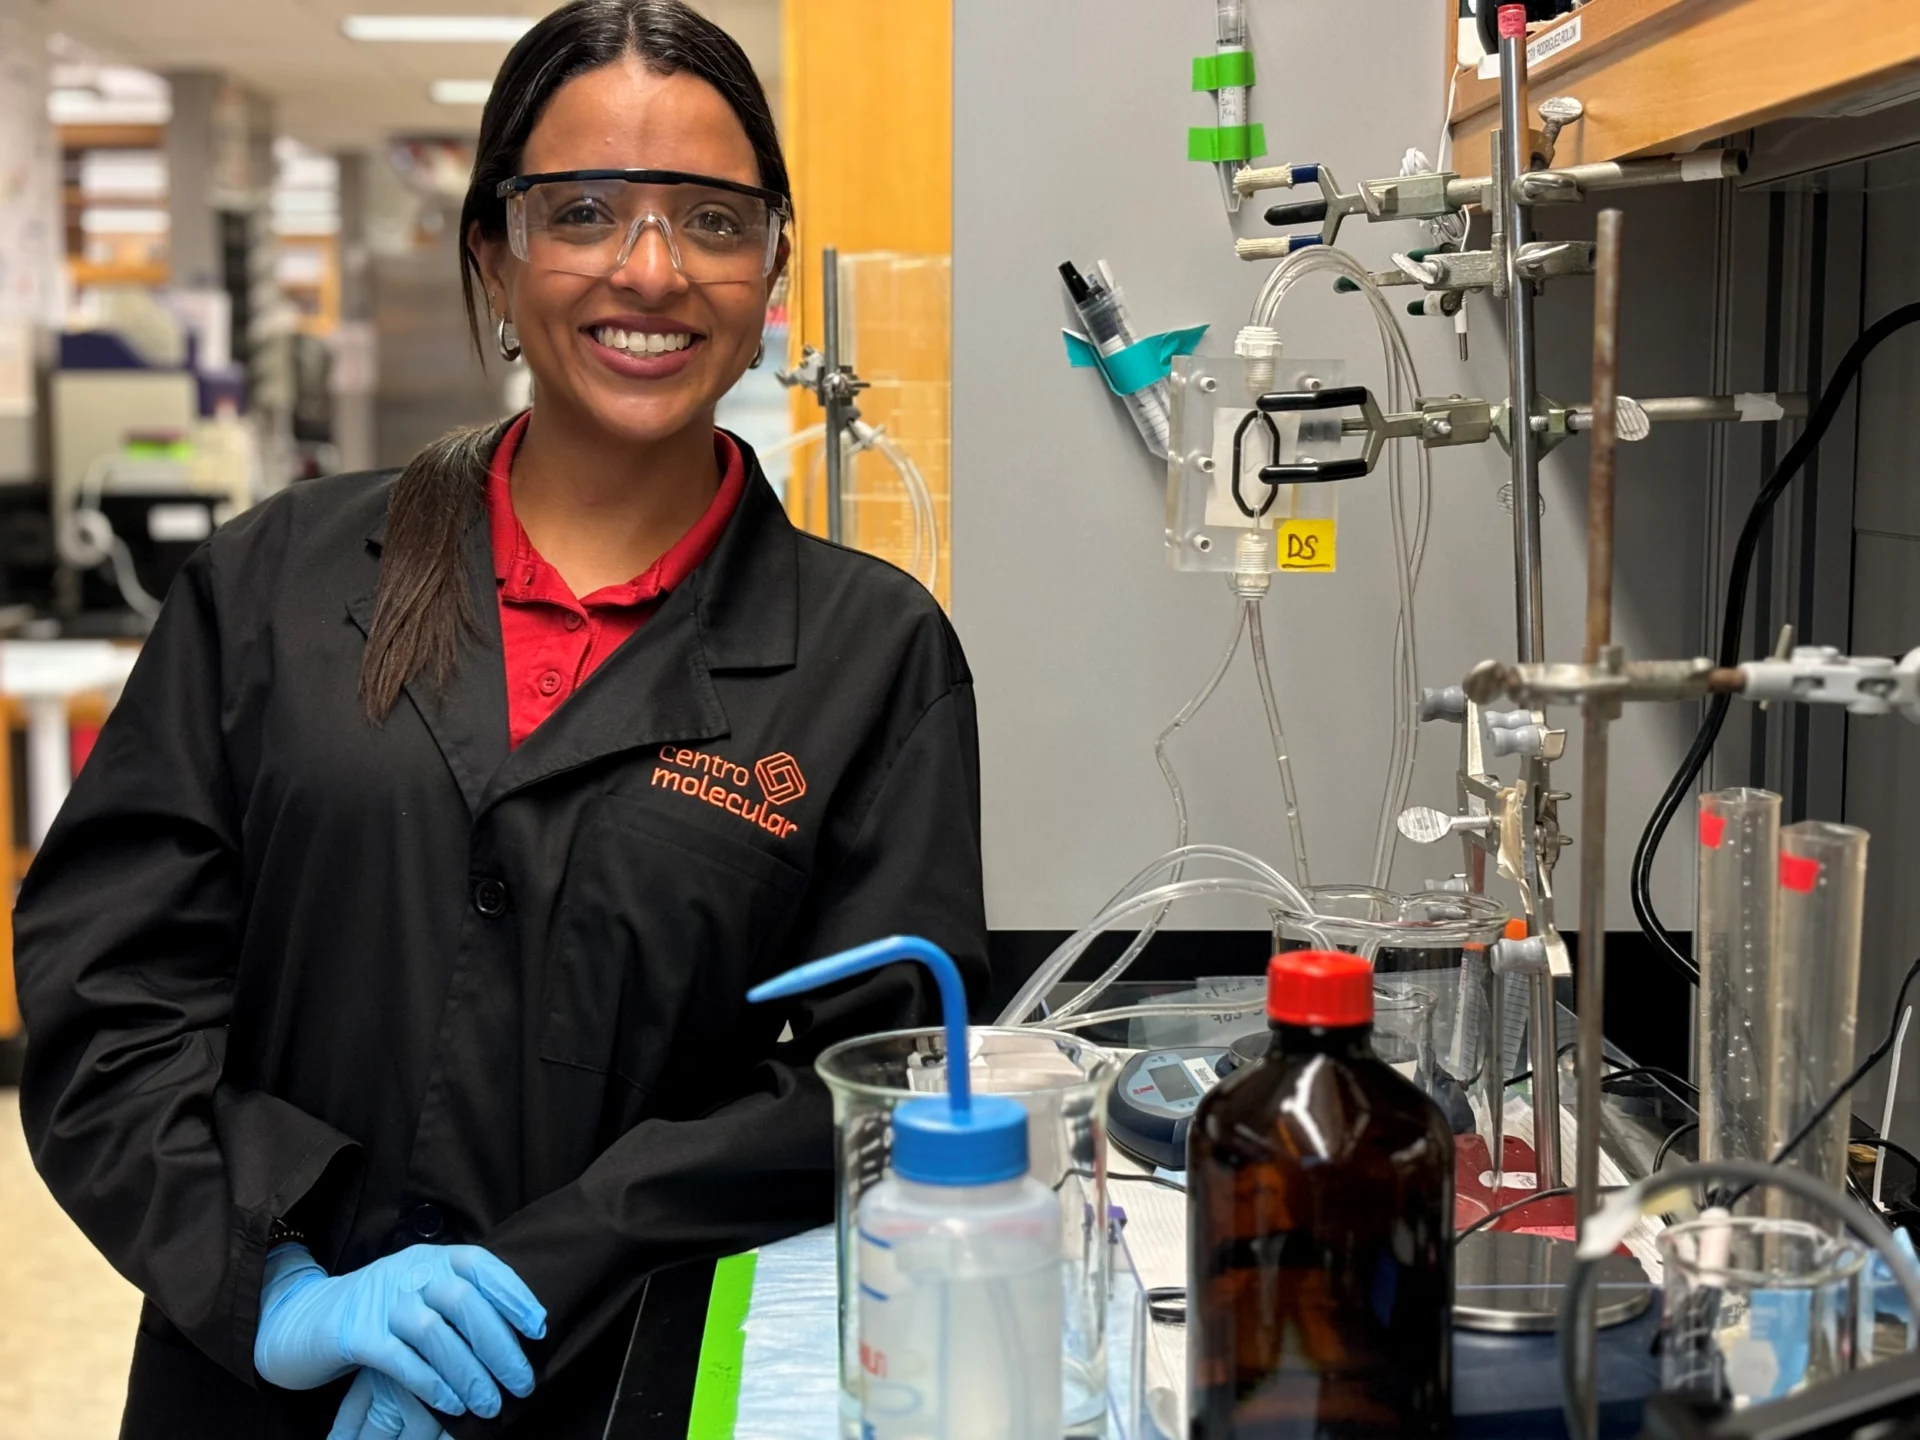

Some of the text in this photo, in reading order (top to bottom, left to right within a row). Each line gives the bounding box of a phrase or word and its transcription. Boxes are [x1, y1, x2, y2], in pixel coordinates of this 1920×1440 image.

[1288, 533, 1319, 560] DS
[659, 745, 750, 787] centro
[650, 766, 798, 839] molecular
